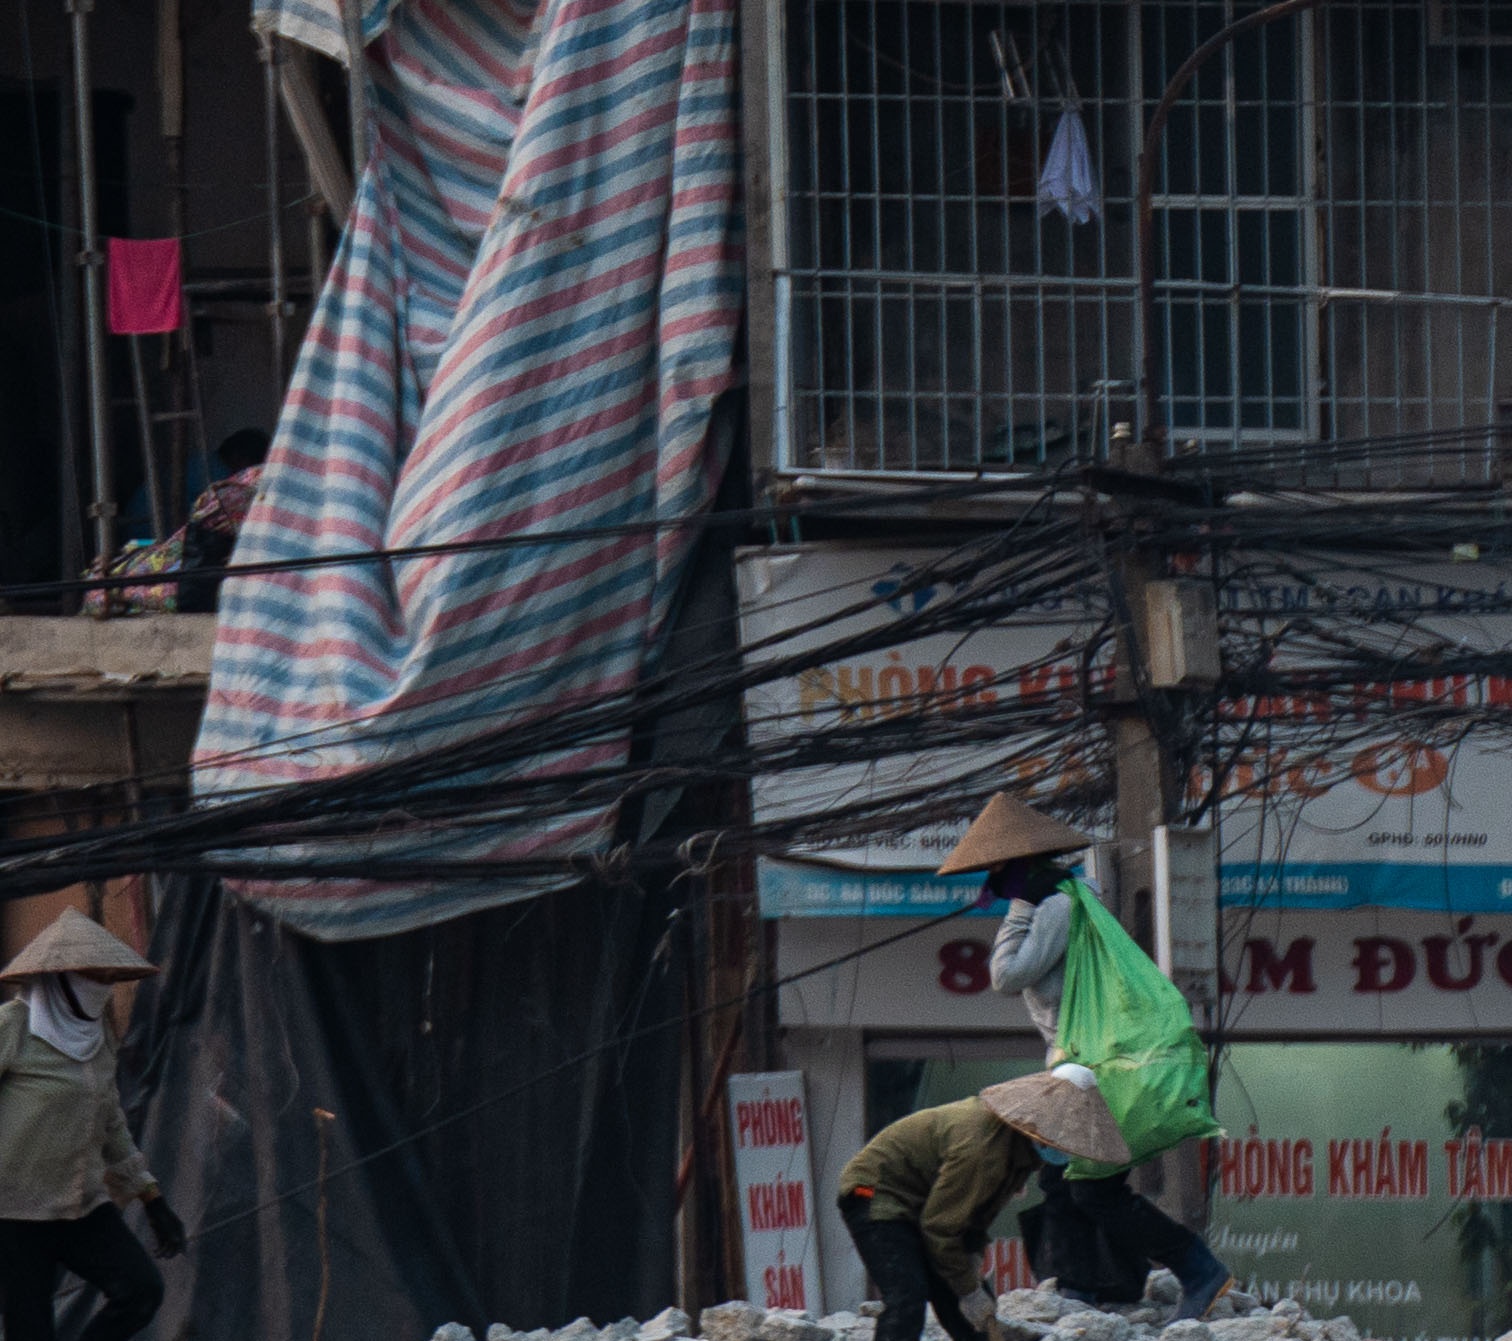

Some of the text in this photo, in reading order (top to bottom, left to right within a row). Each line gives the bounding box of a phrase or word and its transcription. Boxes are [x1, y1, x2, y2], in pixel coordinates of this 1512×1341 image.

[1328, 1126, 1428, 1199] KHÁM
[747, 1170, 808, 1233] KHÁM
[1288, 1279, 1341, 1309] PHỤ
[1349, 1279, 1423, 1304] KHOA
